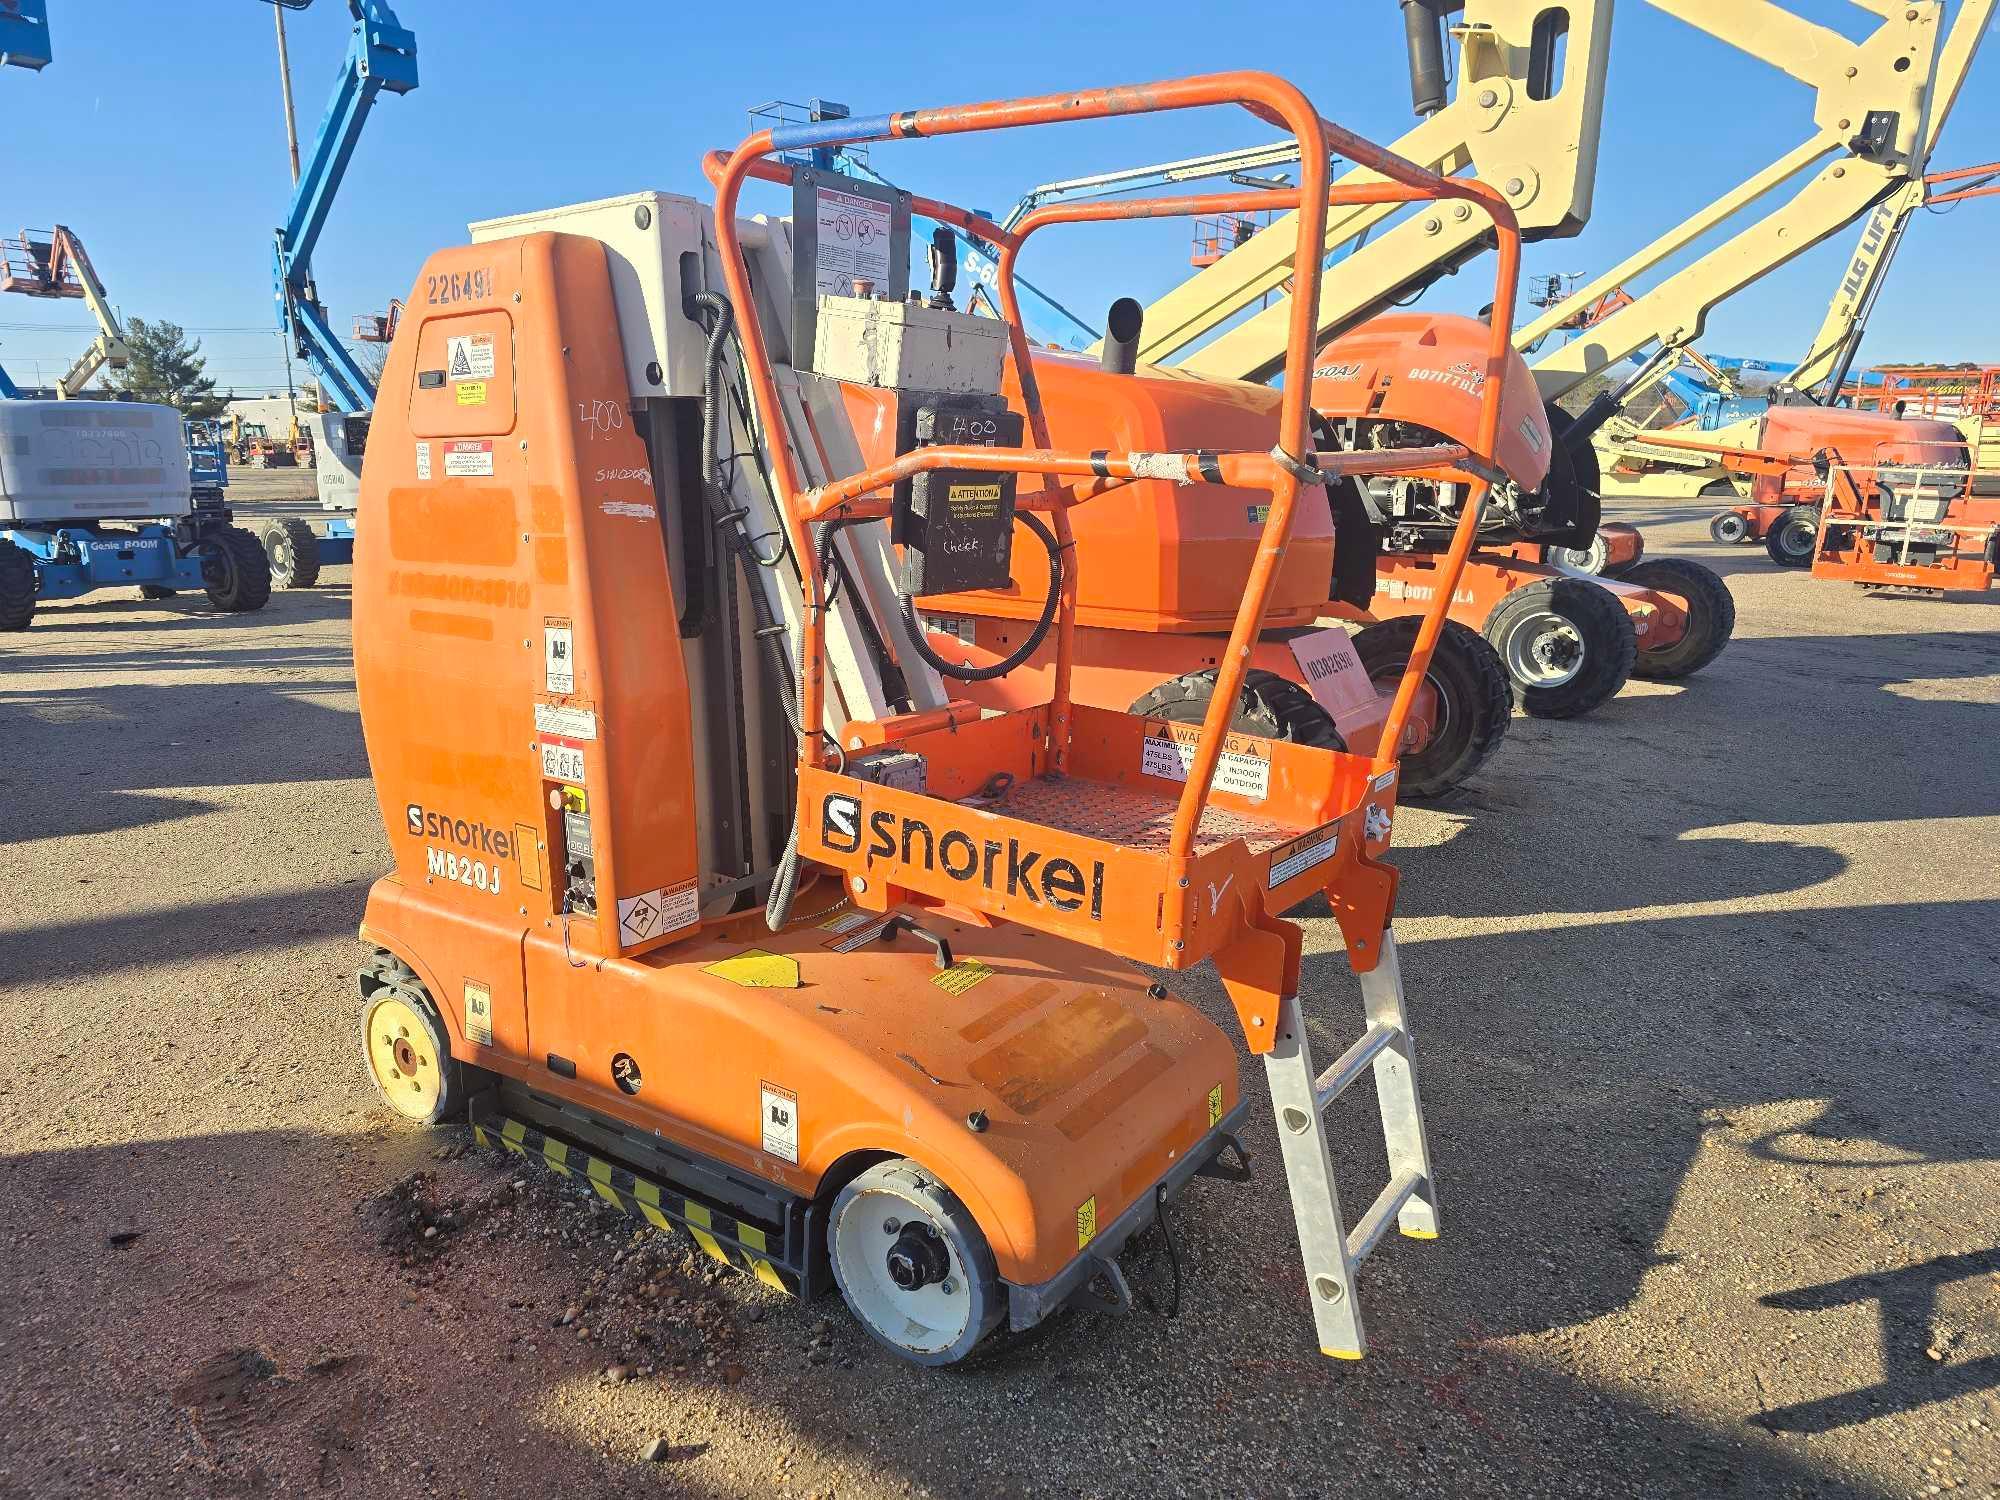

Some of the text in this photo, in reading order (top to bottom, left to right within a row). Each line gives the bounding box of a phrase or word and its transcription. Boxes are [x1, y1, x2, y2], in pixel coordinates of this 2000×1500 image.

[844, 196, 873, 209] DANGER
[1843, 202, 1893, 301] JLG LIFT
[579, 399, 622, 440] 400
[953, 417, 997, 440] 400
[957, 488, 994, 499] ATTENTION
[91, 540, 158, 551] Genie BOOM
[1145, 739, 1181, 752] MAXIMUM
[1229, 753, 1269, 768] CAPACITY
[1146, 750, 1173, 761] 475LBS
[1229, 767, 1261, 779] INDOOR
[1145, 761, 1172, 772] 475LBS
[1223, 776, 1263, 791] OUTDOOR
[427, 812, 516, 861] snorkel
[426, 845, 501, 895] MB20J
[869, 811, 1105, 921] snorkel
